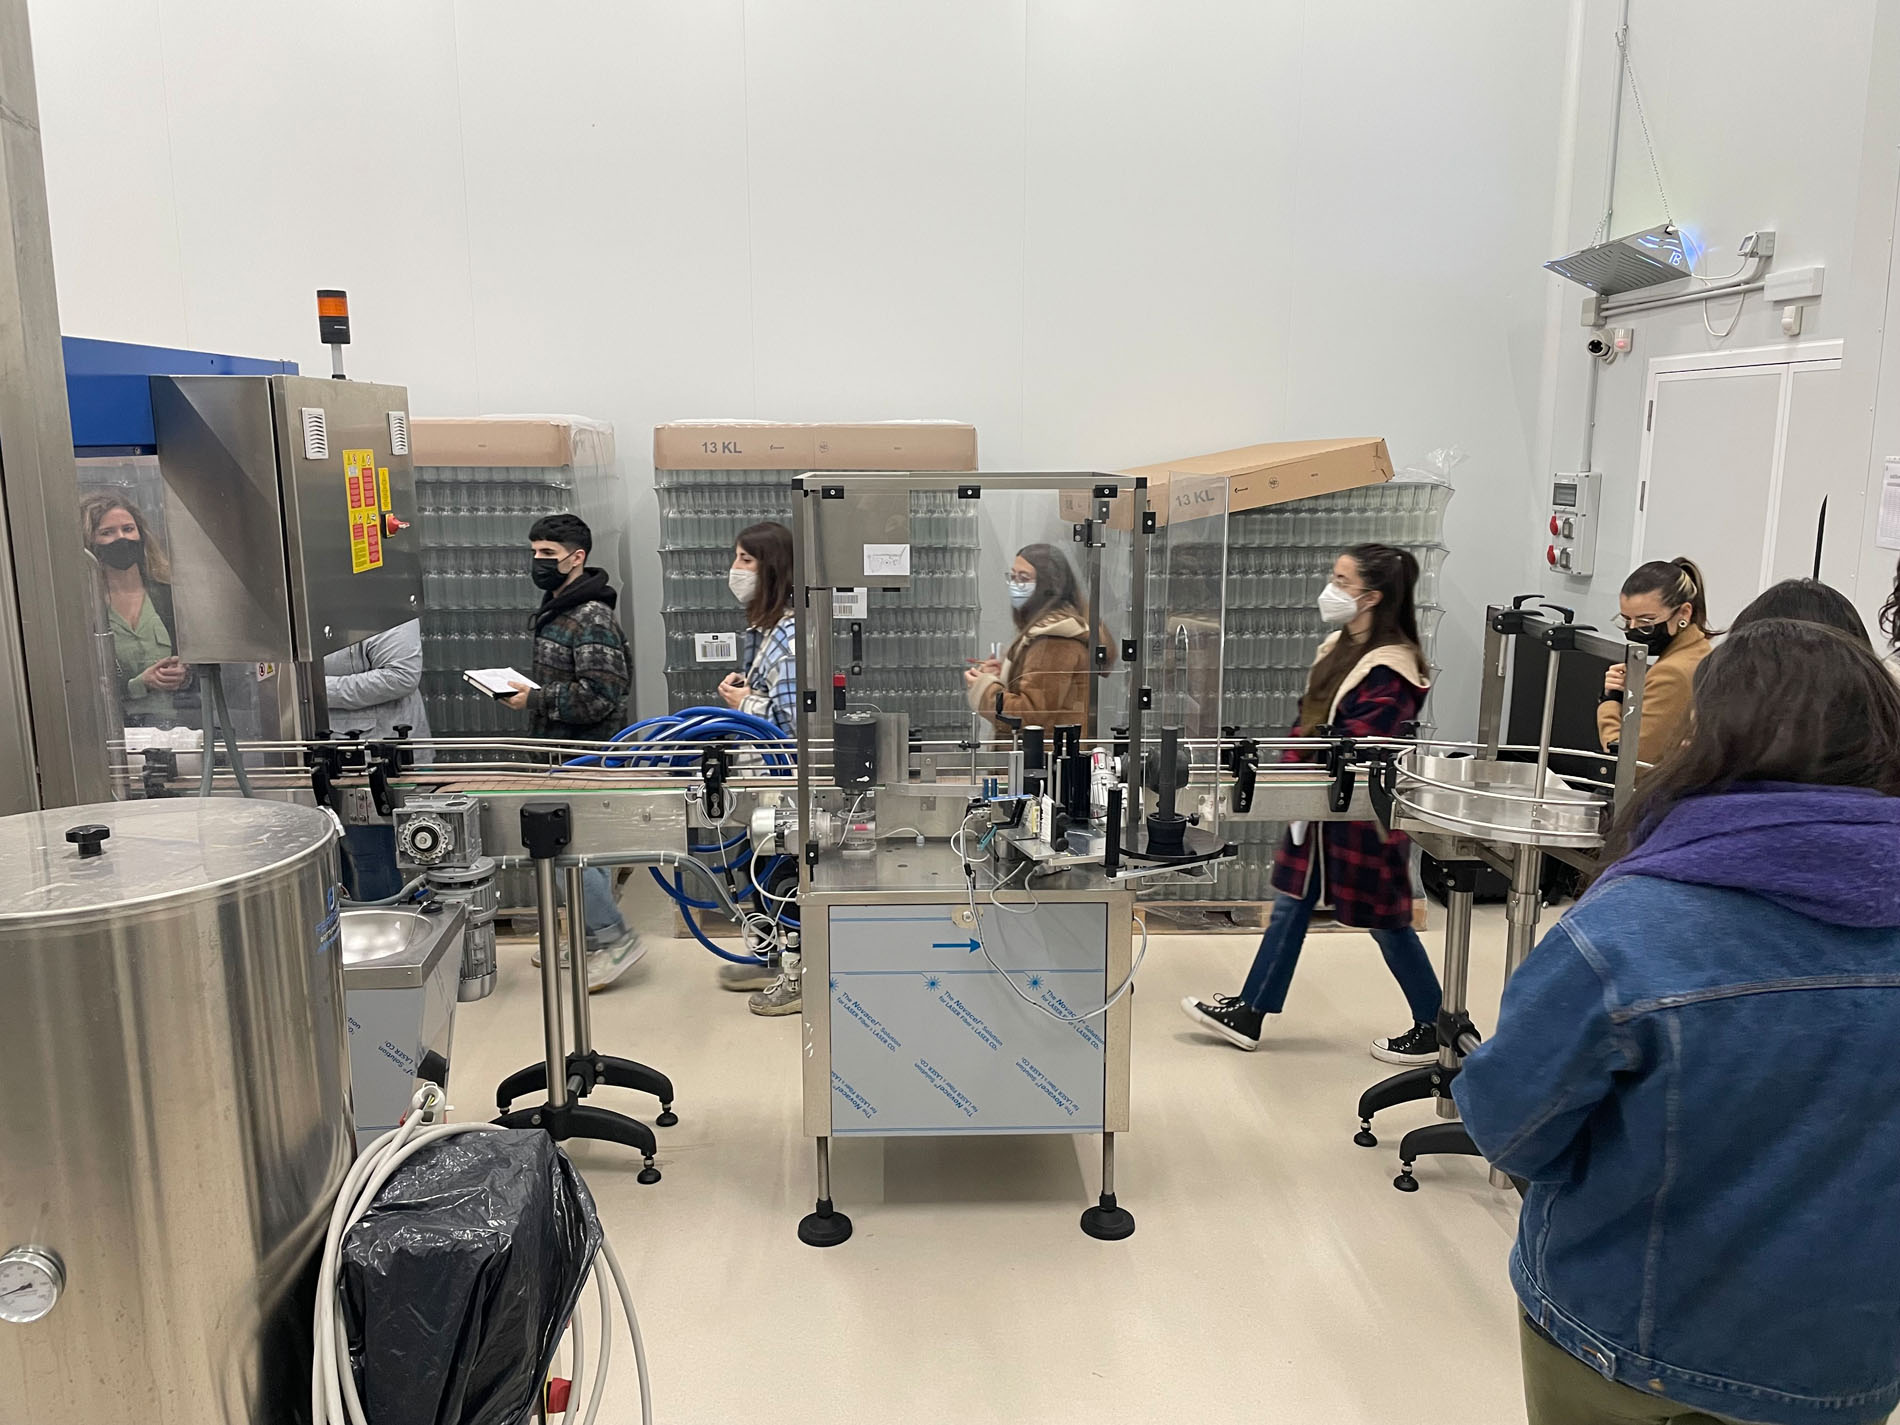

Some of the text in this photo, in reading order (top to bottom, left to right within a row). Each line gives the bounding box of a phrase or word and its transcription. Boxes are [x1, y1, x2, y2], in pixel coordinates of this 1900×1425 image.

[702, 442, 742, 454] 13 KL
[1176, 490, 1214, 507] 13 KL
[1047, 989, 1056, 1000] The
[842, 992, 852, 1002] The
[881, 1027, 901, 1047] Solution
[843, 1003, 859, 1017] LASER
[873, 1030, 888, 1043] LASER
[944, 991, 954, 1001] The
[982, 1026, 1003, 1046] Solution
[945, 1002, 960, 1016] LASER
[975, 1029, 989, 1042] LASER
[1048, 1001, 1063, 1015] LASER
[1076, 1027, 1091, 1041] LASER
[379, 1046, 404, 1068] Solution
[395, 1049, 413, 1064] LASER
[915, 1063, 935, 1083] Solution
[928, 1066, 943, 1080] LASER
[1016, 1062, 1036, 1082] Solution
[1029, 1065, 1044, 1079] LASER
[856, 1094, 870, 1108] LASER
[957, 1092, 972, 1106] LASER
[1058, 1091, 1072, 1104] LASER
[862, 1109, 872, 1119] The
[963, 1107, 973, 1117] The
[1064, 1106, 1073, 1116] The
